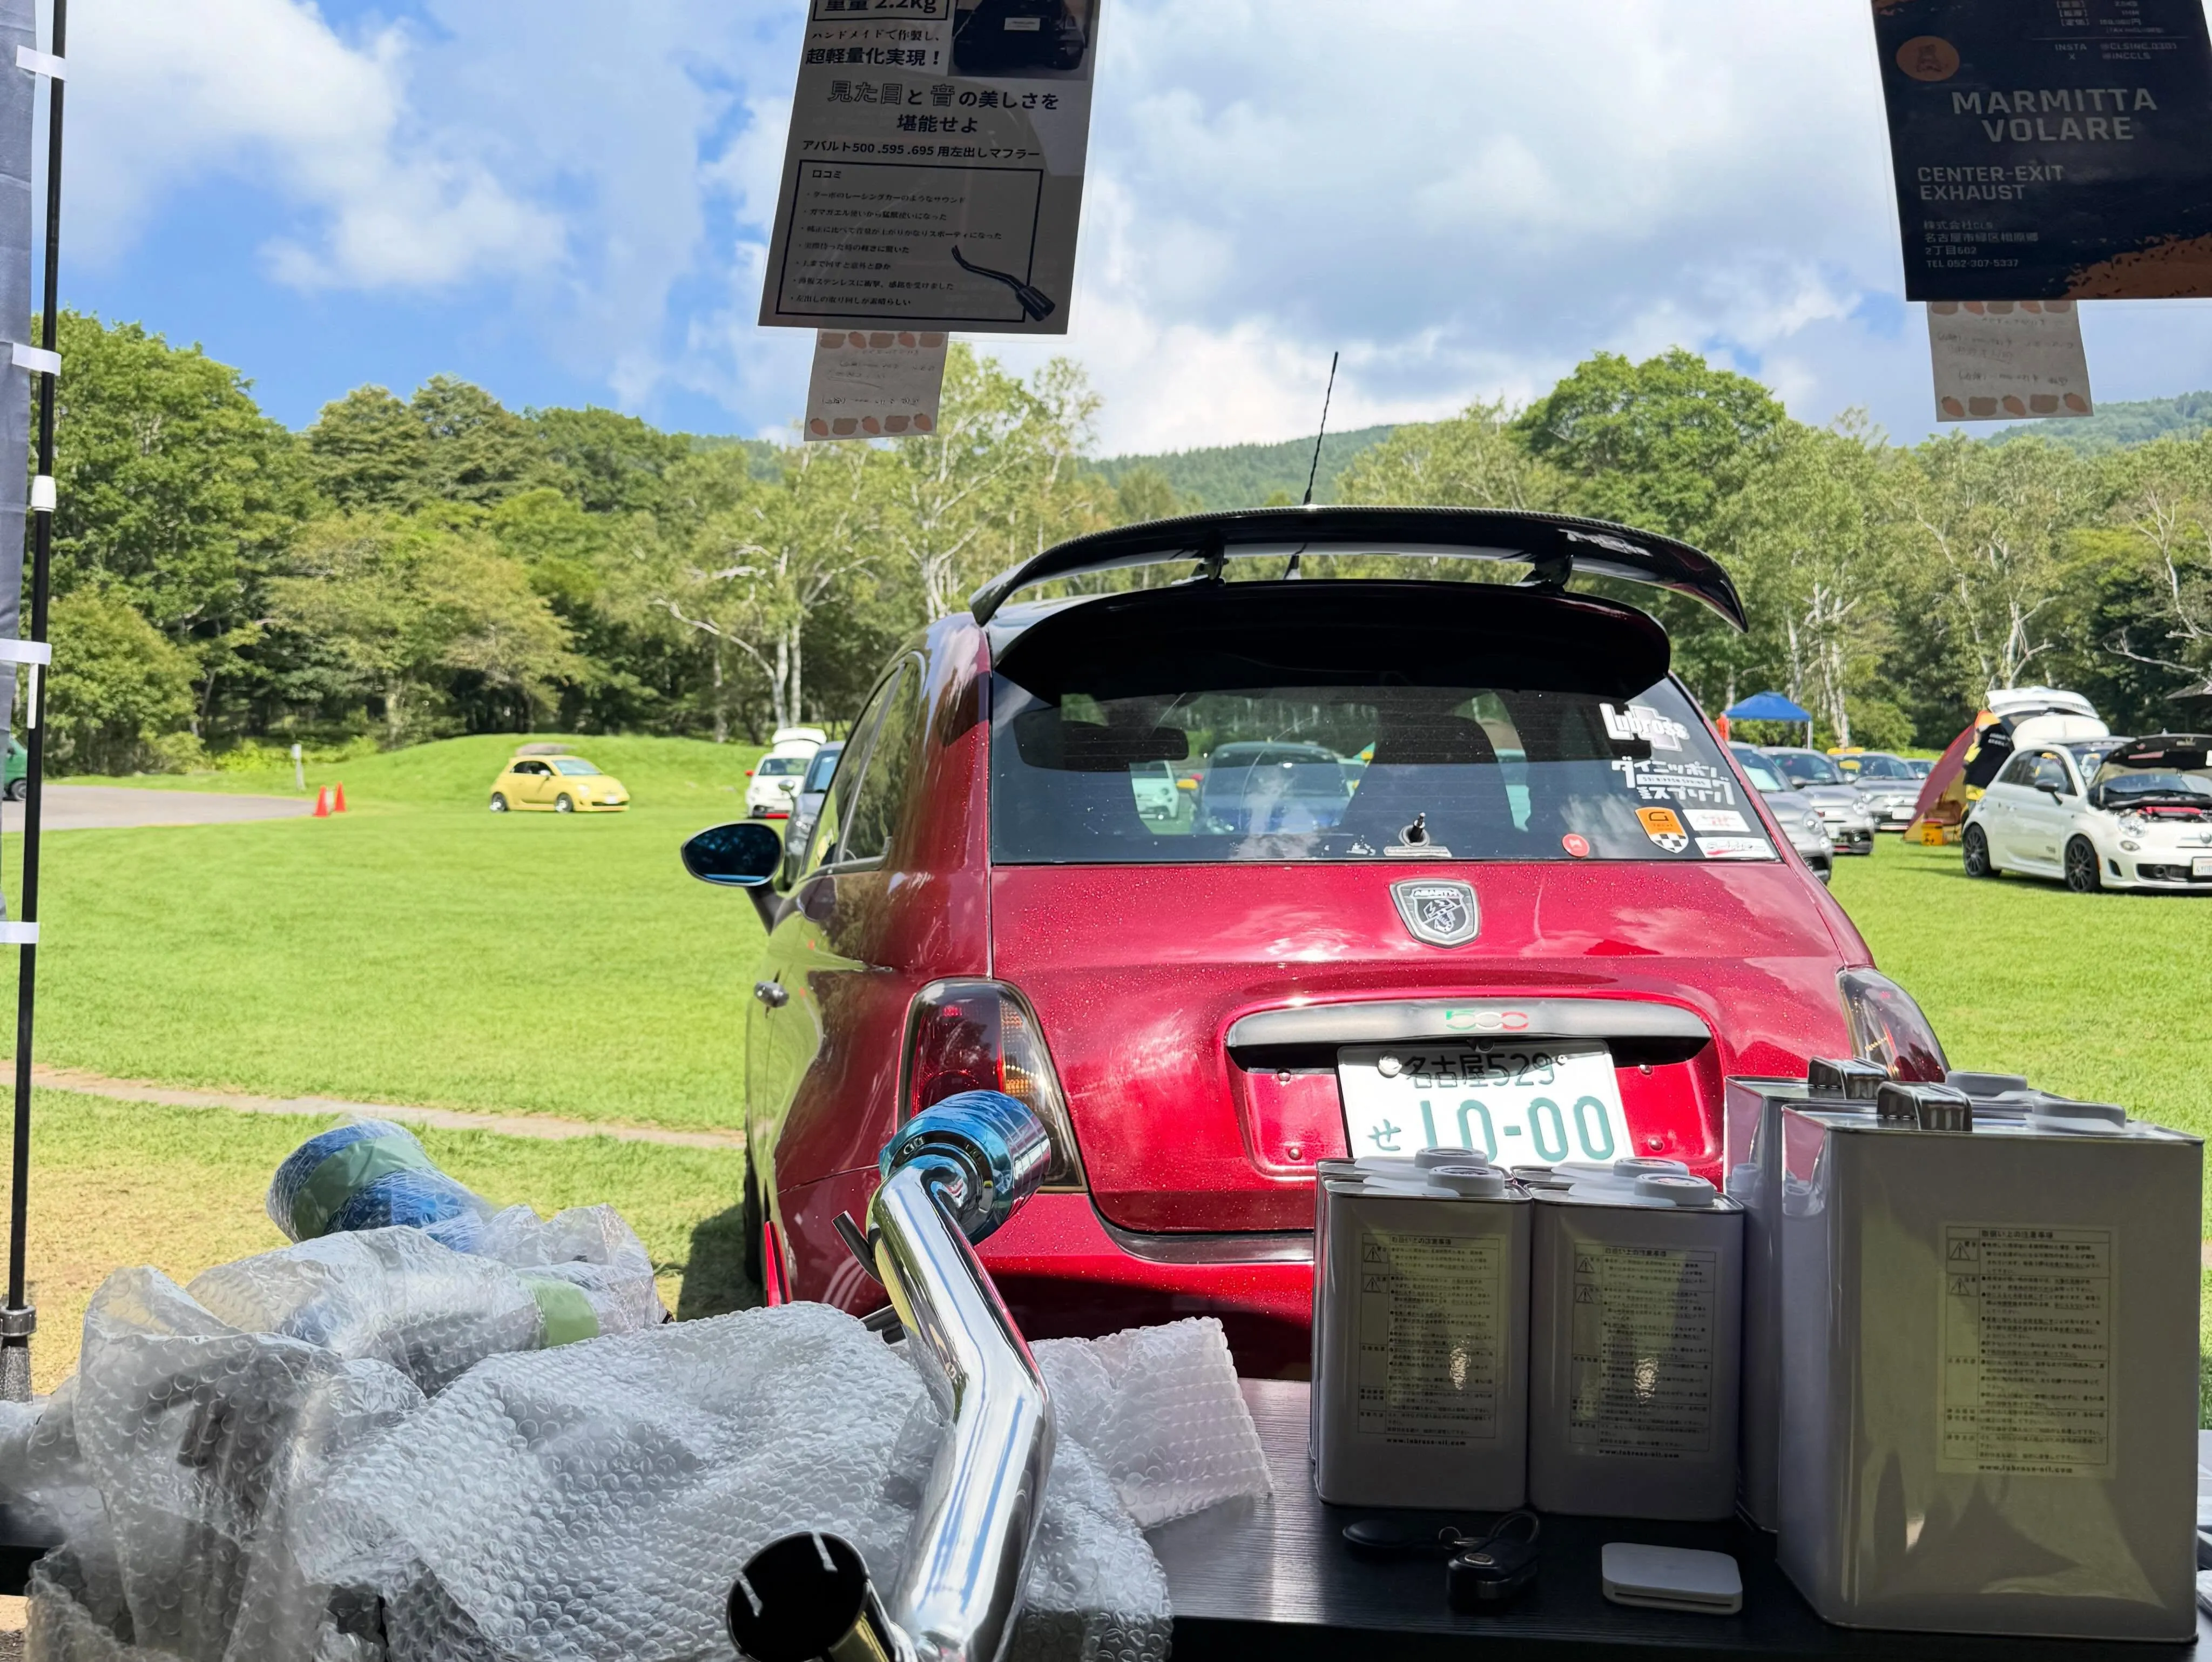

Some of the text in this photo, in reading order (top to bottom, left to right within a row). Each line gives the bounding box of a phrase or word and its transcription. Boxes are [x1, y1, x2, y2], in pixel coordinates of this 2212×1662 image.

[812, 29, 940, 42] ハンドメイドで作製し、
[805, 47, 940, 66] 超軽量化実現！
[1952, 88, 2158, 115] MARMITTA
[896, 114, 979, 133] 堪能せよ
[1981, 117, 2134, 143] VOLARE
[812, 169, 842, 179] 口コミ
[1917, 165, 2064, 183] CENTER-EXIT
[1920, 185, 2025, 200] EXHAUST
[1926, 260, 1944, 268] TEL
[1446, 1008, 1529, 1031] 500
[1368, 1095, 1616, 1163] せ 10-00
